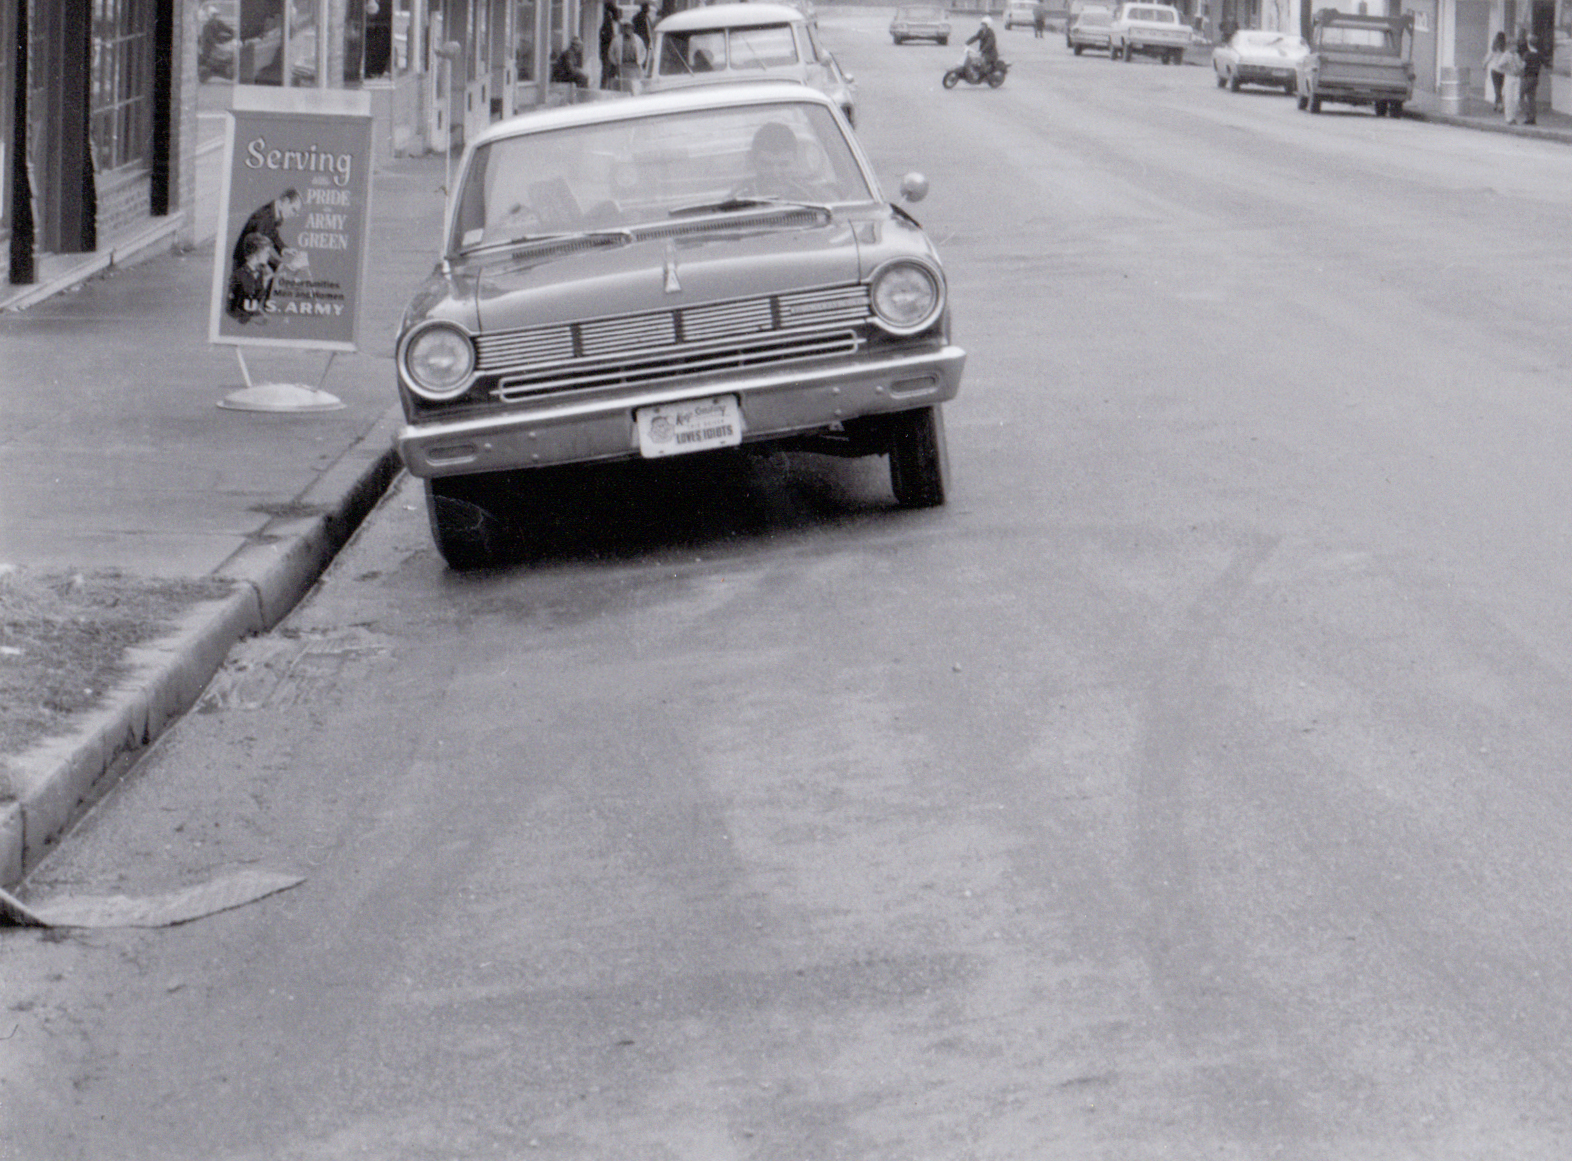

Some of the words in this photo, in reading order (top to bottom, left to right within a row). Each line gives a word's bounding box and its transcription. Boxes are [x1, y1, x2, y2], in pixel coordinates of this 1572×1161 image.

[245, 138, 352, 187] Serving
[306, 189, 350, 206] PRIDE
[305, 212, 348, 230] ARMY
[298, 231, 349, 250] GREEN
[284, 300, 345, 317] ARMY
[676, 429, 702, 444] LOVES
[702, 424, 734, 440] IDIOTS
